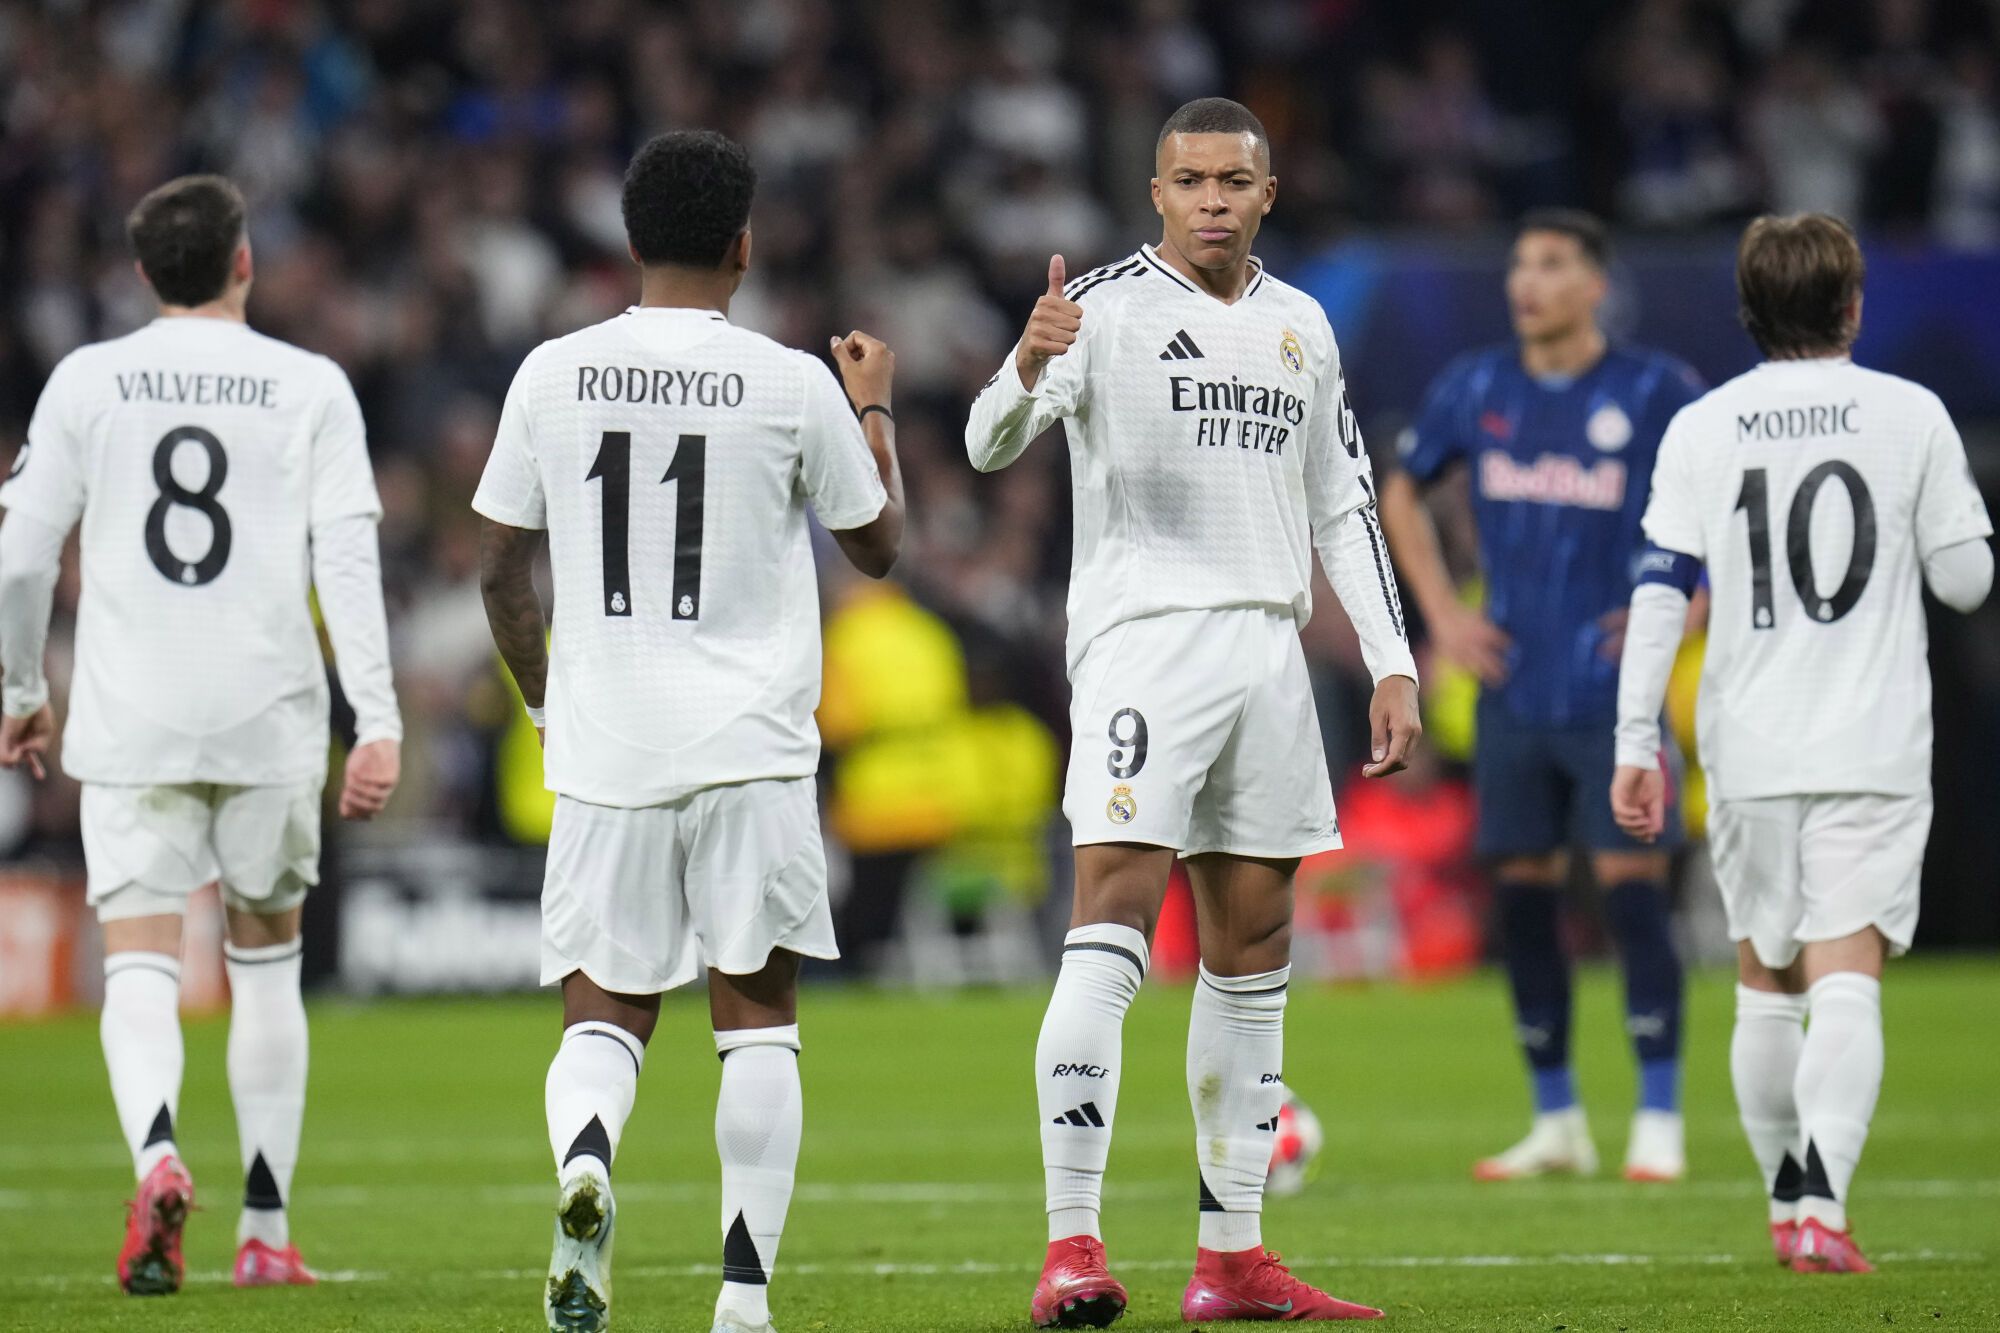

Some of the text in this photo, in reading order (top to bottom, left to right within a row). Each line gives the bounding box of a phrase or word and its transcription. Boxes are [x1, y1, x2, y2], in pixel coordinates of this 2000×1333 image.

[117, 371, 279, 408] VALVERDE
[577, 366, 744, 408] RODRYGO
[1169, 375, 1306, 426] Emirates
[1197, 417, 1231, 447] FLY
[1737, 400, 1861, 442] MODRIĆ
[145, 425, 232, 587] 8
[584, 431, 707, 621] 11
[1734, 460, 1877, 630] 10
[1107, 707, 1149, 780] 9
